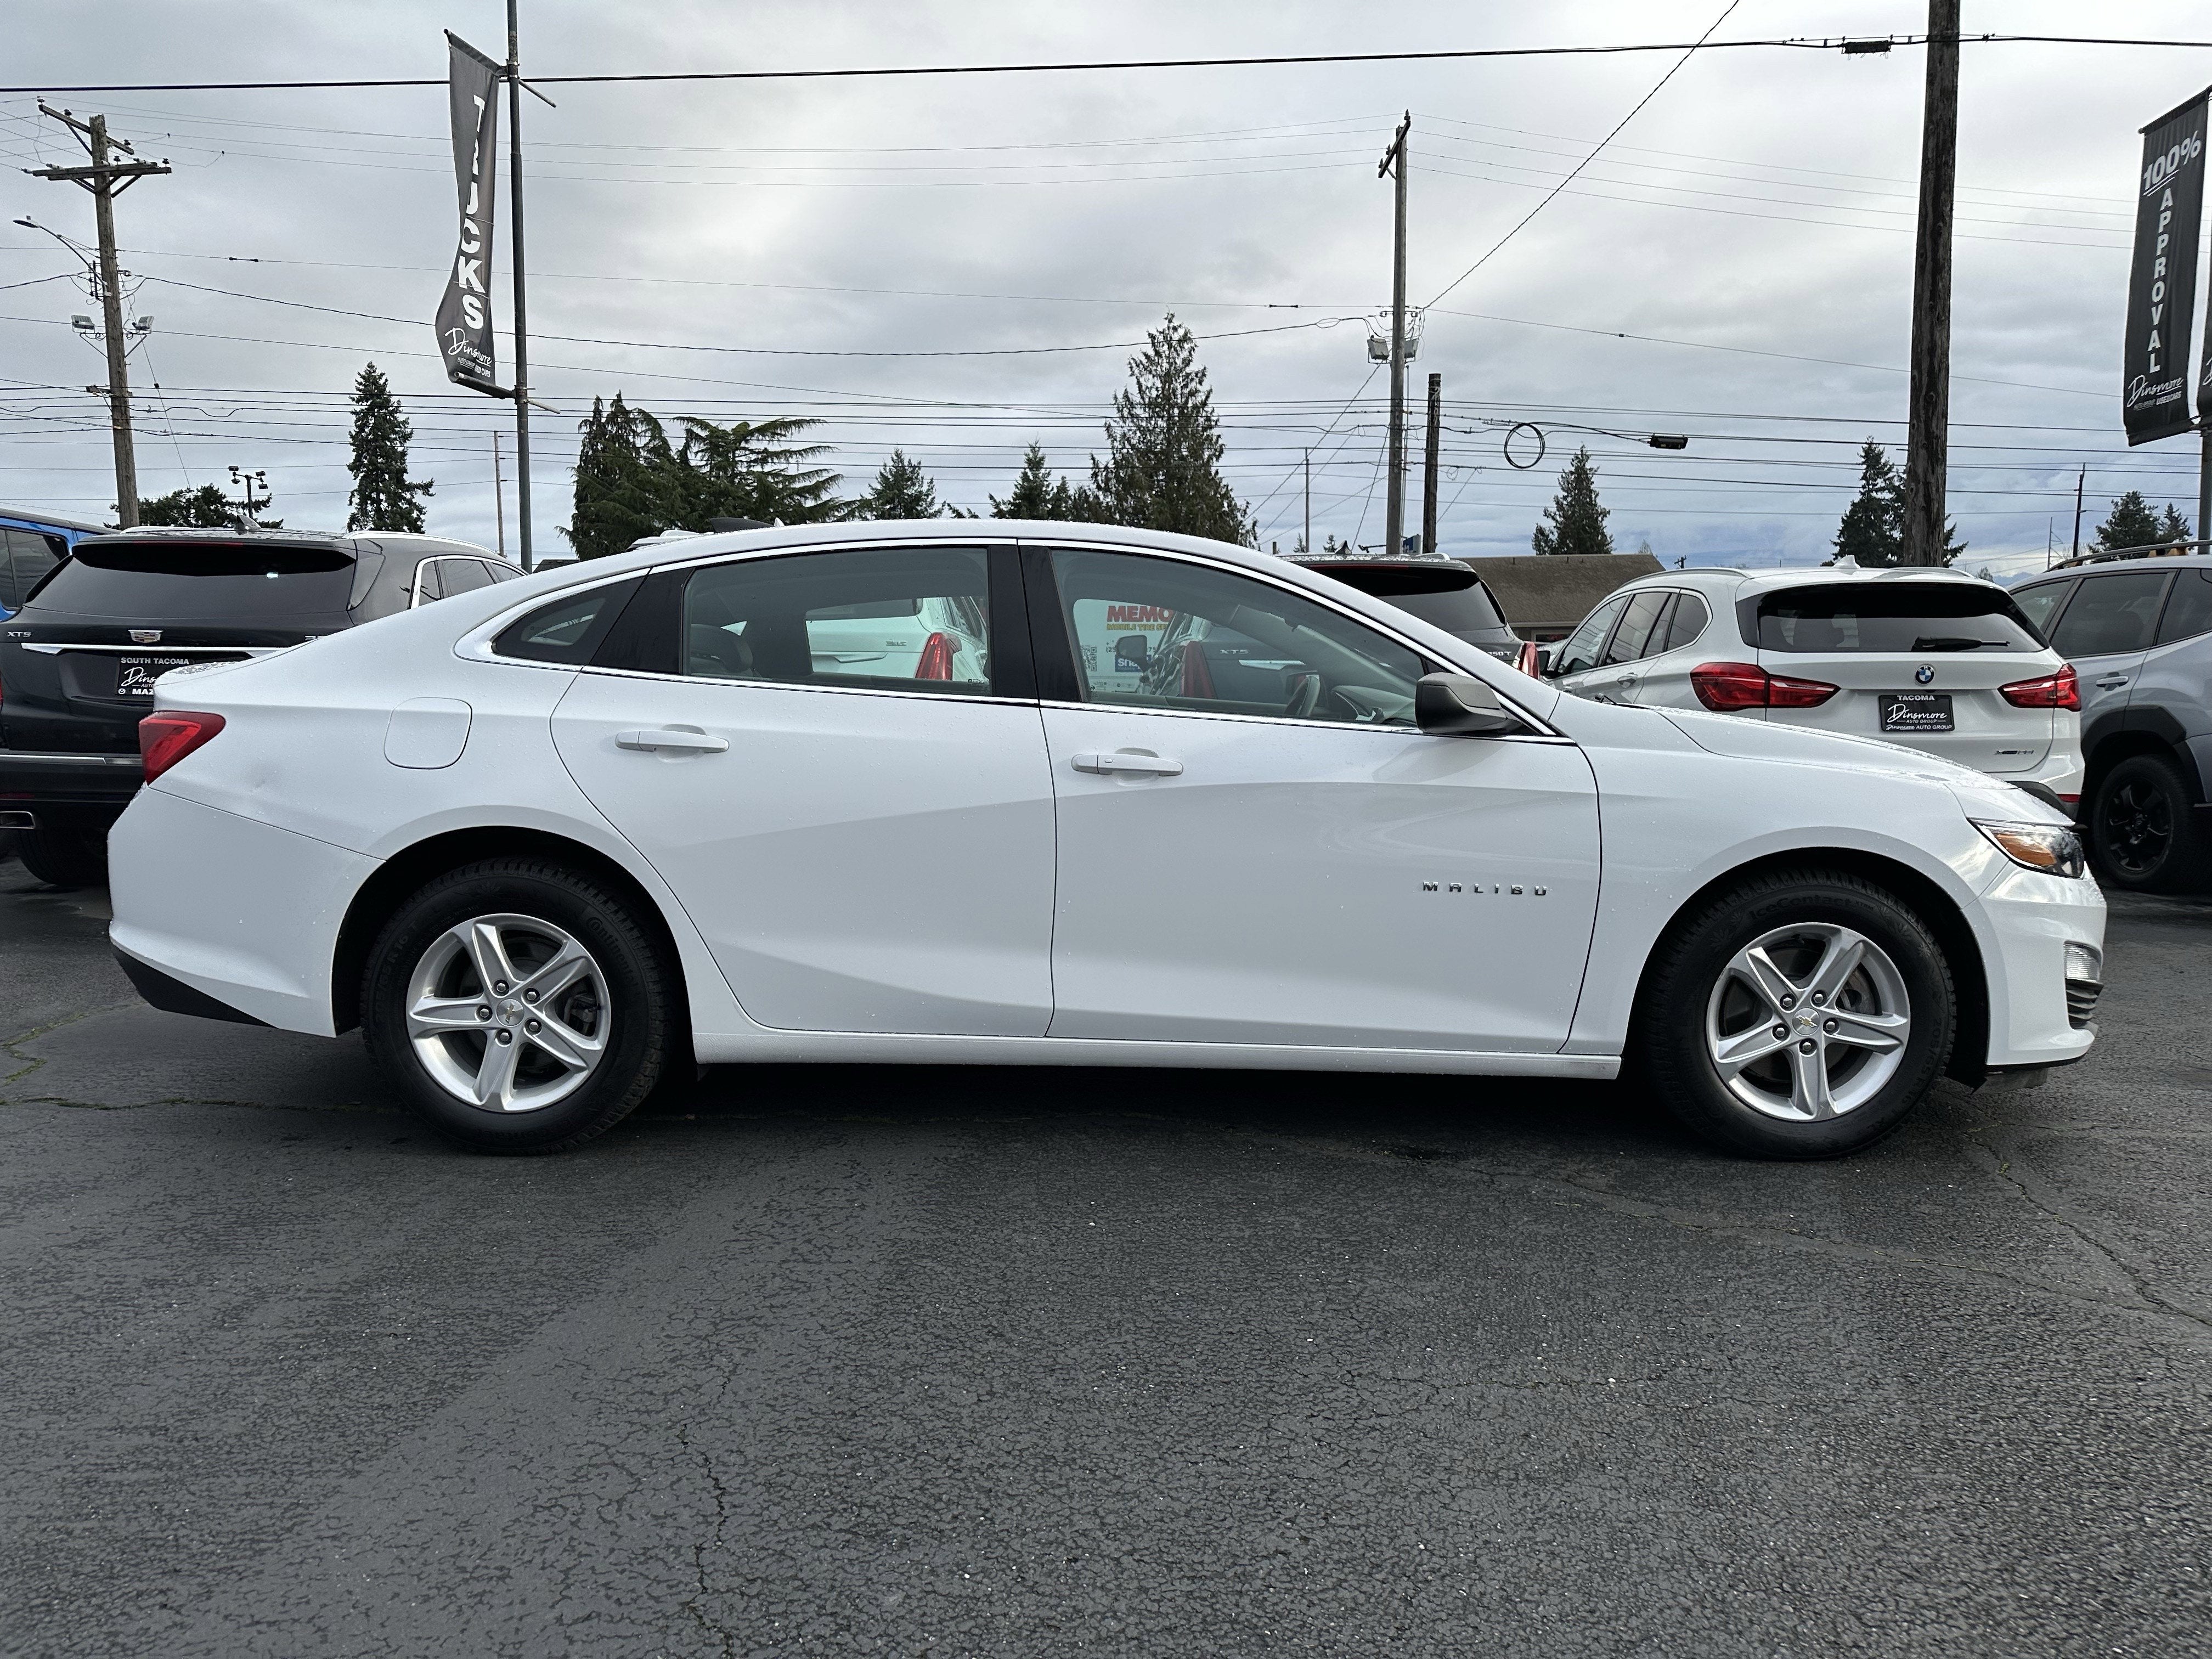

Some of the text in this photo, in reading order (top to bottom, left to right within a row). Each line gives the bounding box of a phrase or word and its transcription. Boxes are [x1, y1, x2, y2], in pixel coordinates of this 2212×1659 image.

[2143, 131, 2201, 190] 100%
[458, 94, 486, 329] TCKS
[2148, 188, 2174, 374] APPROVAL
[445, 328, 492, 364] Dinsmore
[2126, 375, 2185, 408] Dinsmore
[121, 667, 157, 686] Dins
[1887, 704, 1947, 723] Dinsmore
[1423, 881, 1547, 896] MALIBU
[1748, 895, 1851, 919] IceContact
